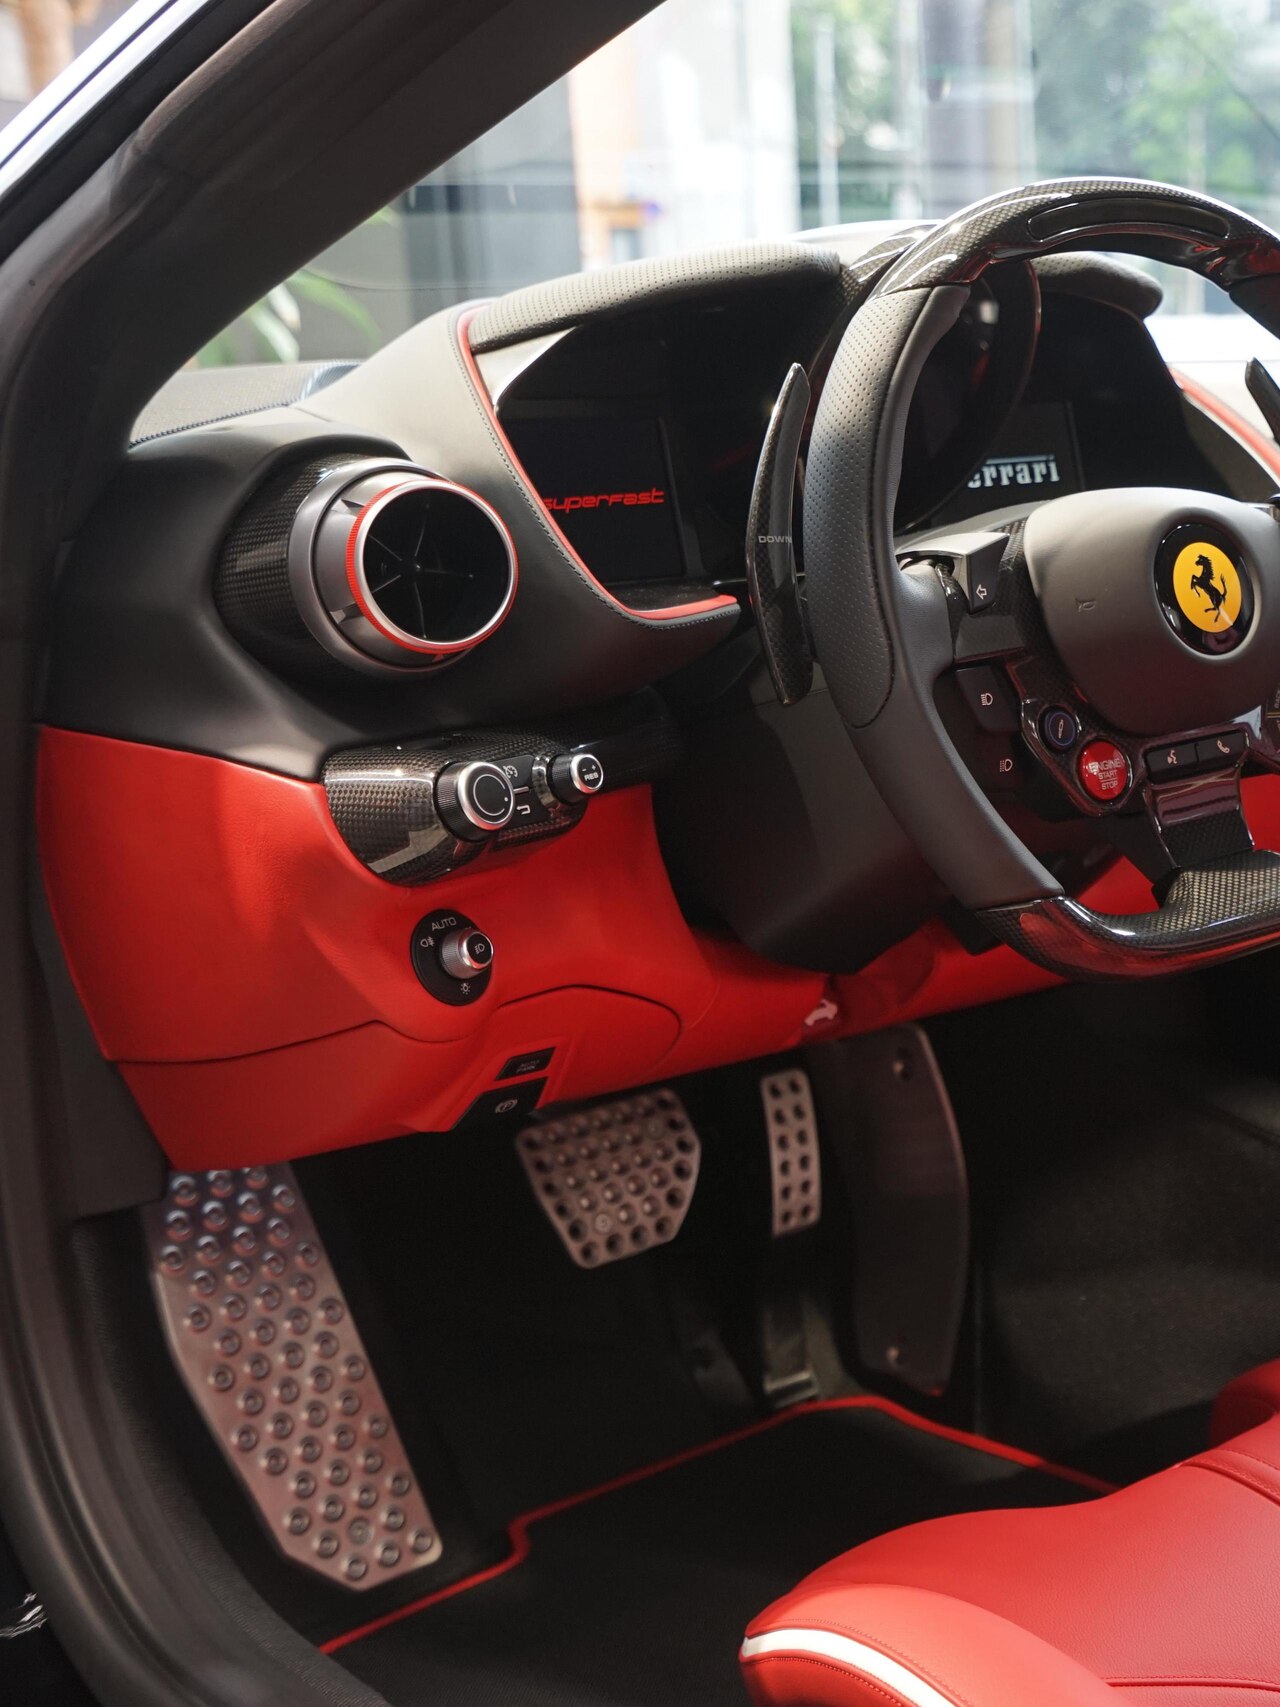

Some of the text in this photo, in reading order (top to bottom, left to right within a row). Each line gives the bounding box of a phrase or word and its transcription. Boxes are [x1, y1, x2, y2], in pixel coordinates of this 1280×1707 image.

[967, 455, 1060, 488] errari
[758, 536, 793, 544] DOWN
[1088, 759, 1121, 773] ENGINE
[584, 772, 598, 781] RES
[1098, 770, 1118, 780] START
[1101, 781, 1118, 790] STOP
[431, 916, 457, 932] AUTO
